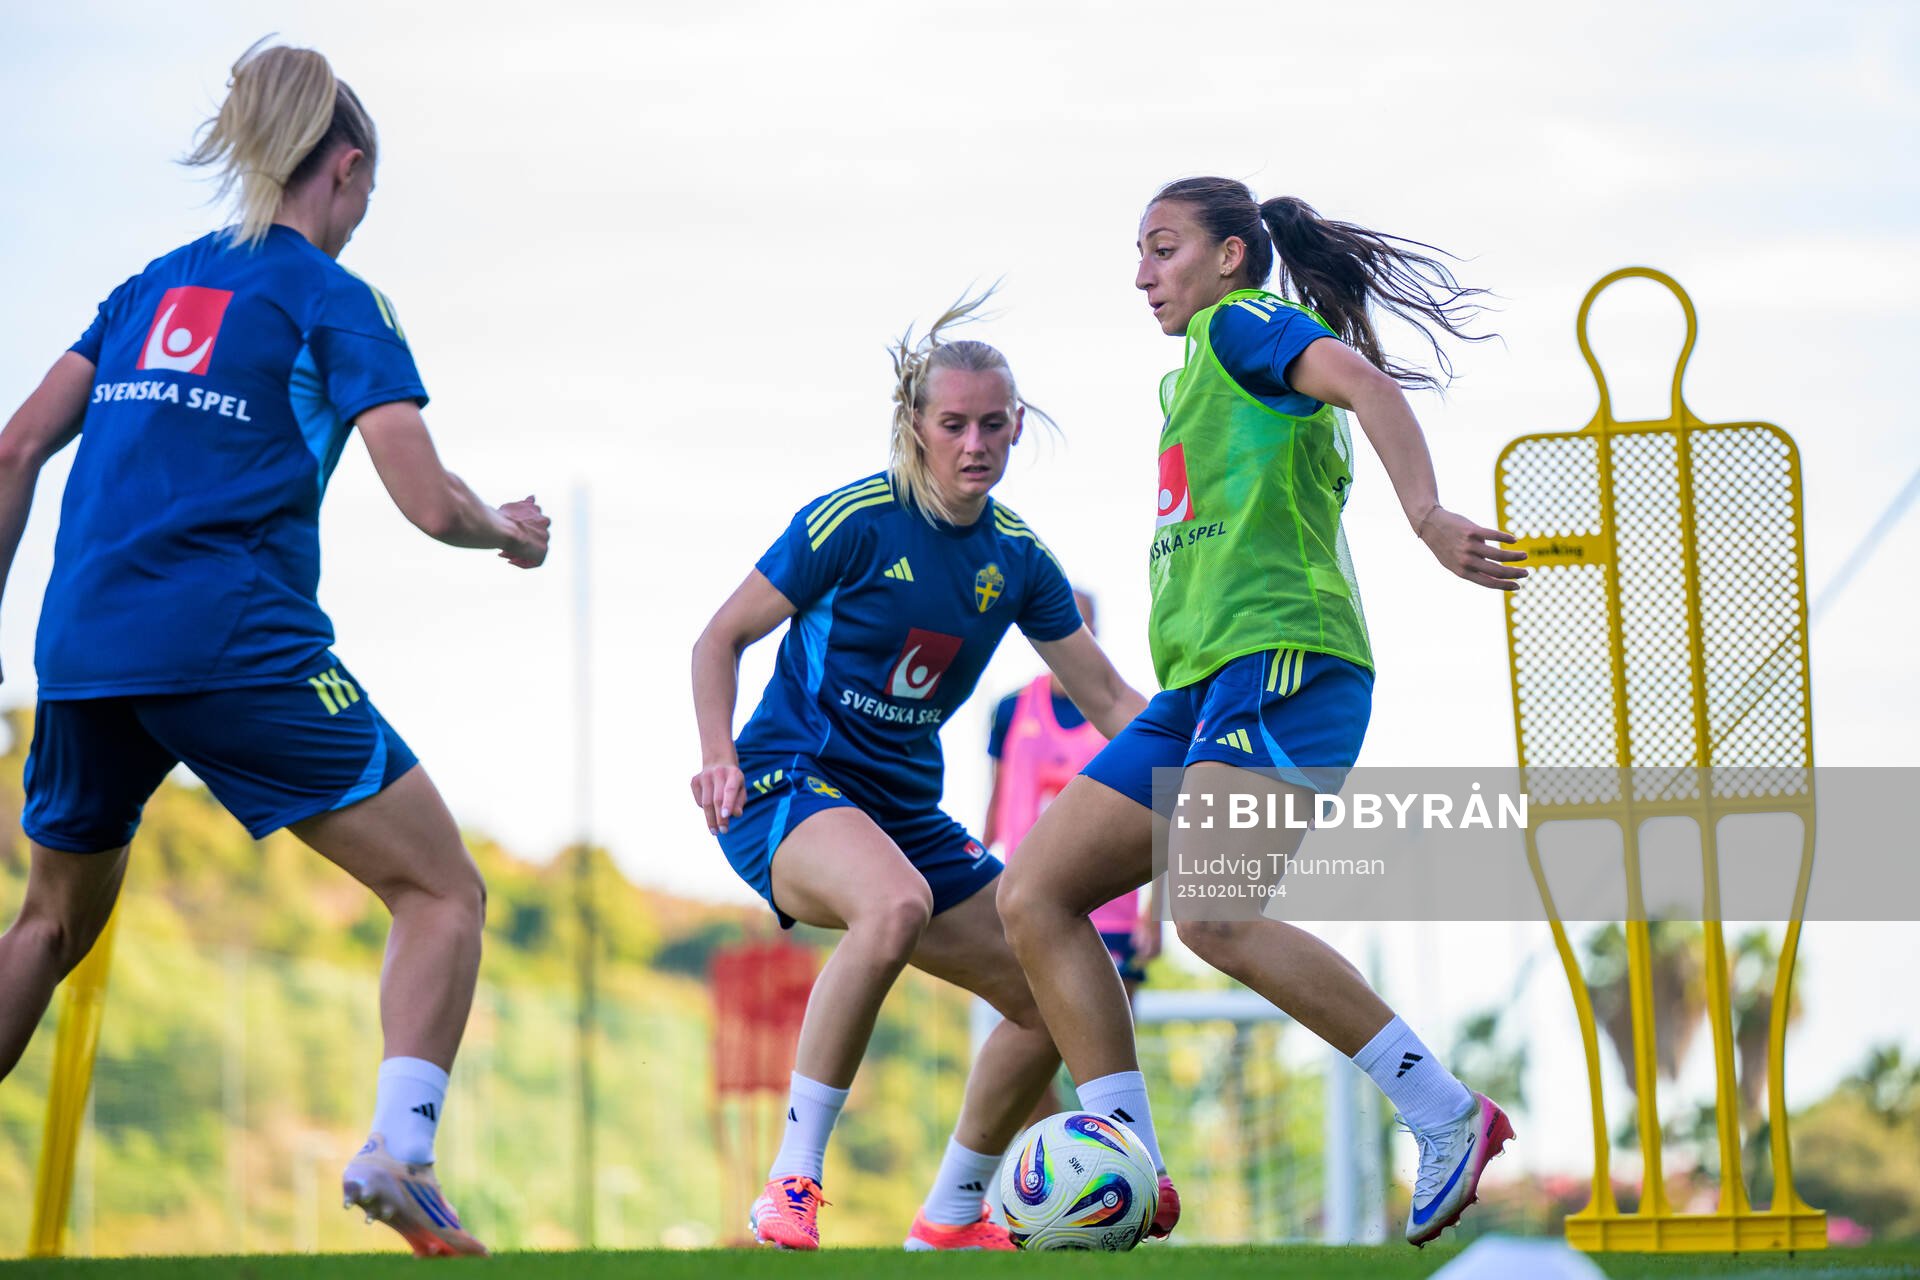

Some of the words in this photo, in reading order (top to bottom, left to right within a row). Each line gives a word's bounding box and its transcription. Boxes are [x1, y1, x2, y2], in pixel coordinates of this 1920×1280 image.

[92, 381, 180, 404] SVENSKA
[186, 388, 251, 422] SPEL
[1188, 521, 1226, 545] SPEL
[840, 689, 914, 724] SVENSKA
[1068, 1157, 1085, 1175] SWE
